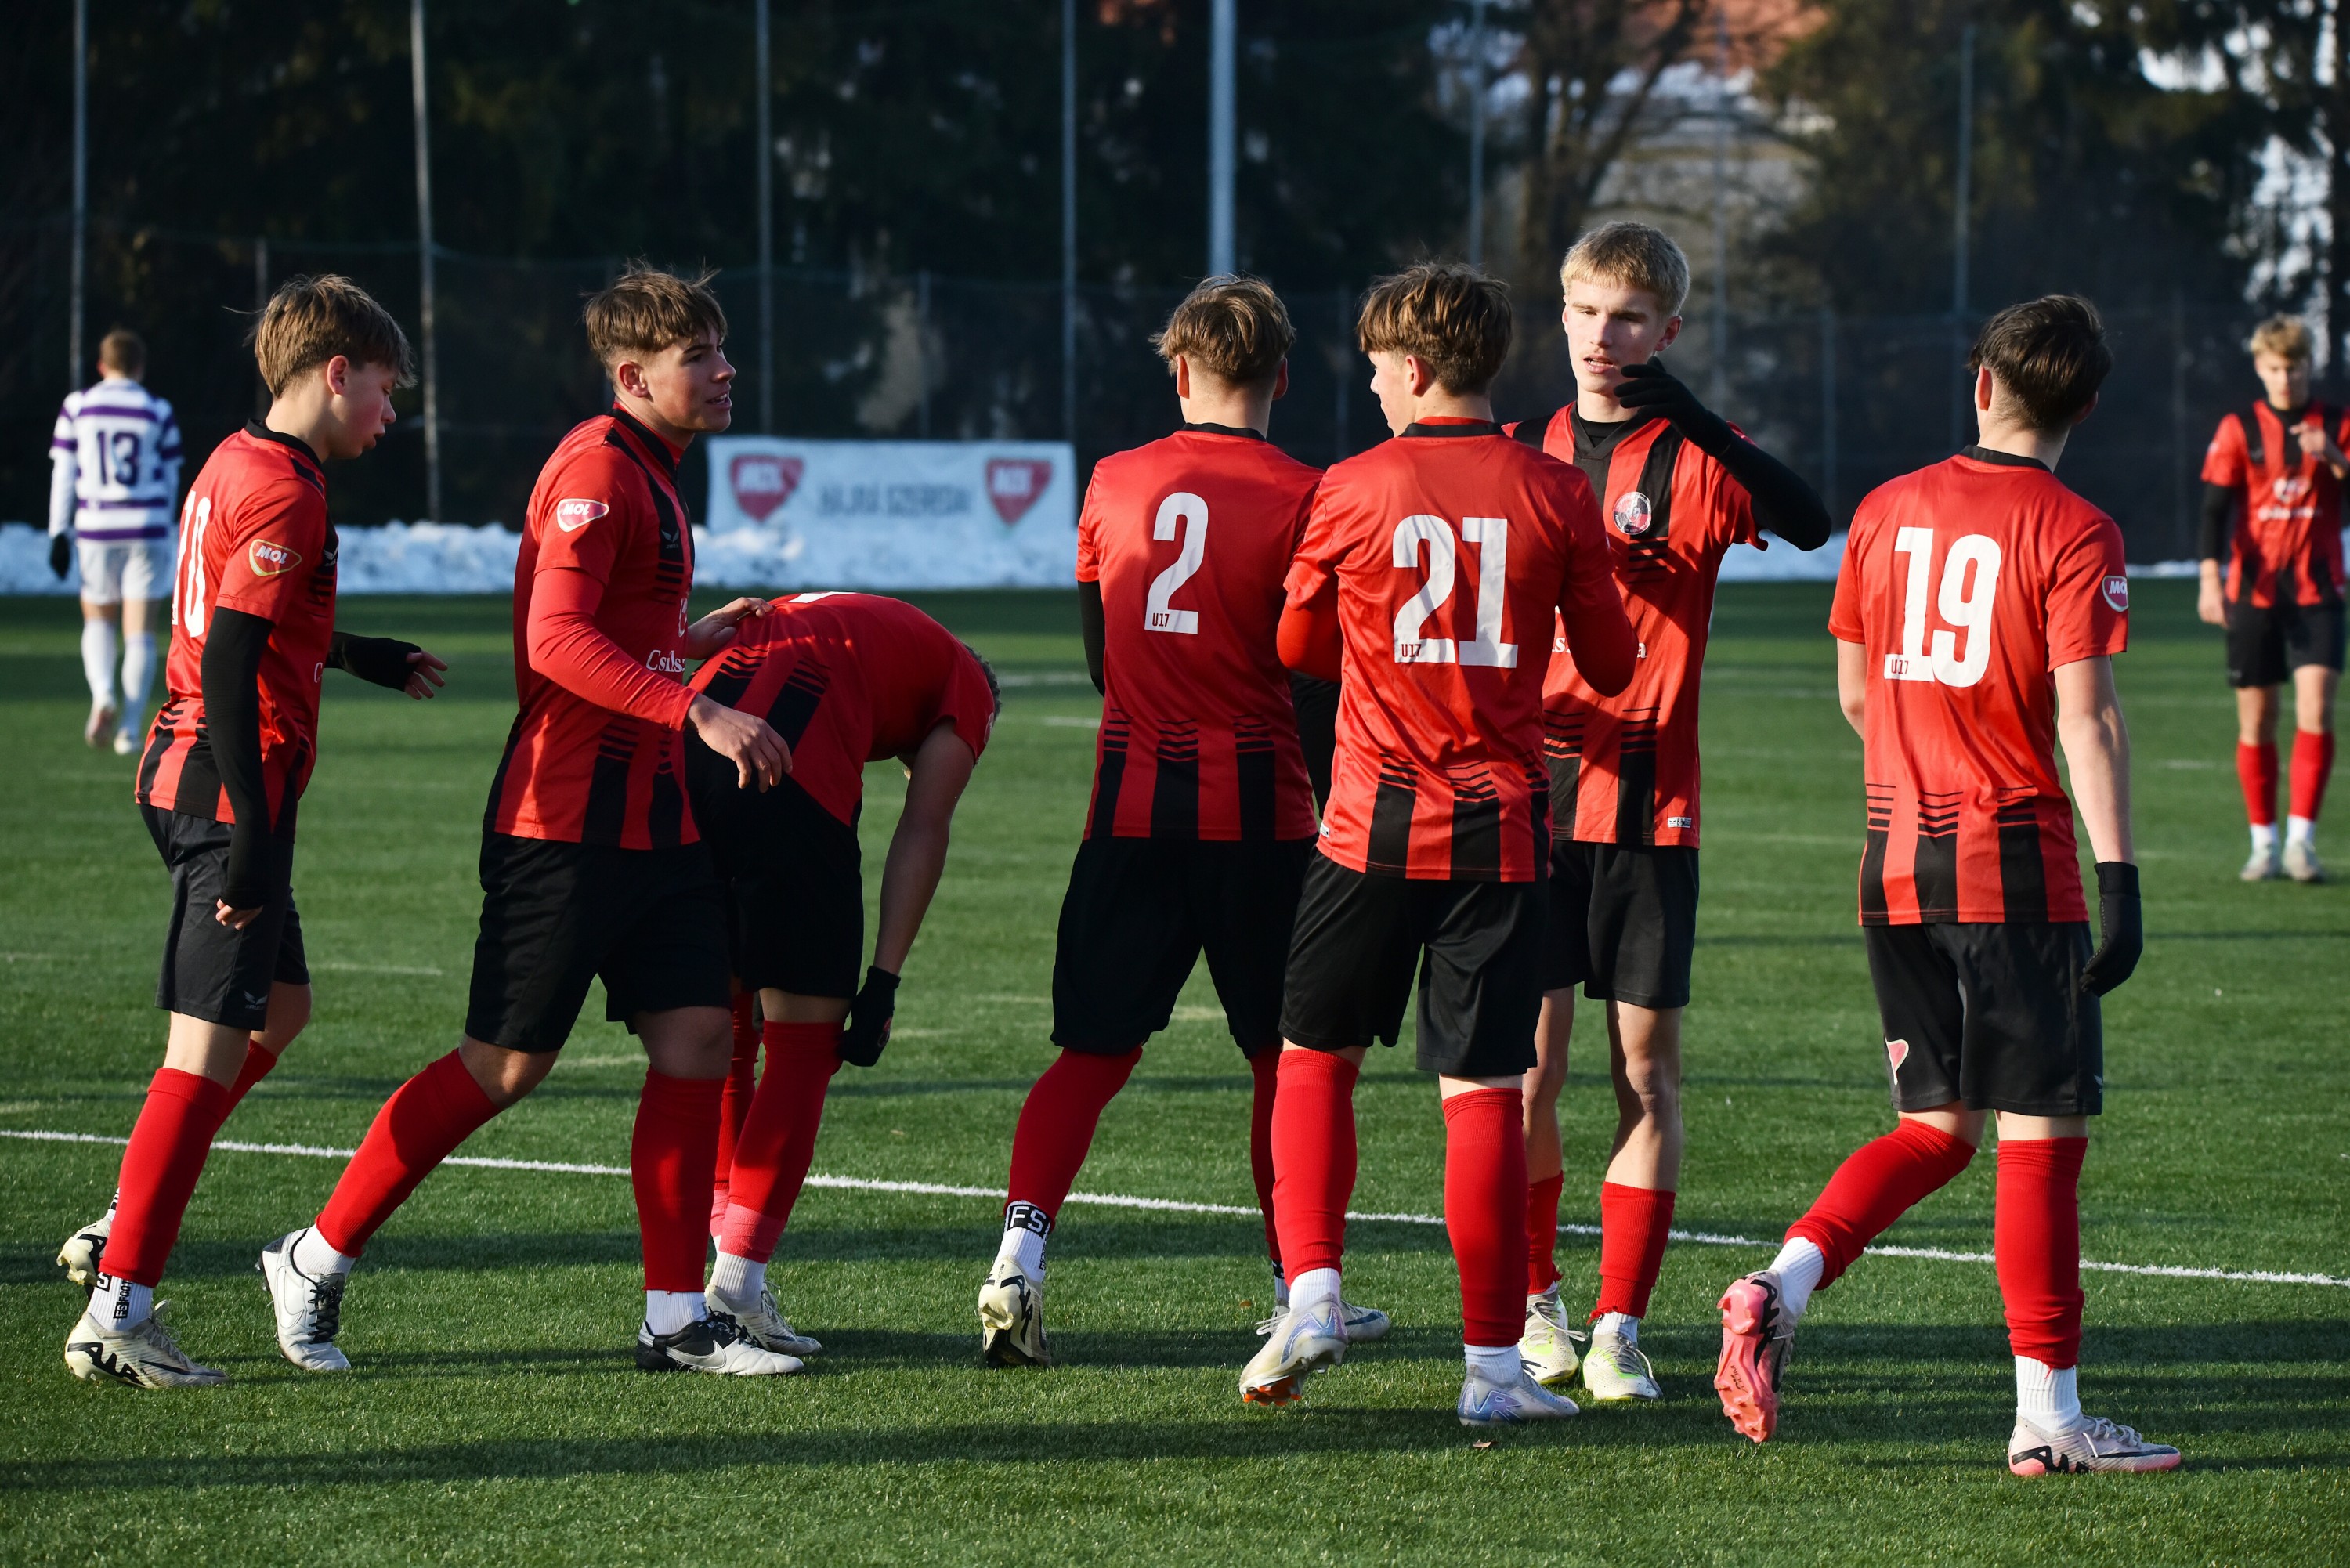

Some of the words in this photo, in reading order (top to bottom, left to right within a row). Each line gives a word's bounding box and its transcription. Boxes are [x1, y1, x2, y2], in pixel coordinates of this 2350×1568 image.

[97, 430, 139, 486] 13
[562, 503, 591, 516] MOL
[255, 544, 288, 564] MOL
[1144, 492, 1209, 635] 2
[1393, 514, 1518, 668] 21
[2109, 580, 2128, 594] MO
[1883, 526, 2002, 688] 19
[1152, 612, 1170, 627] U17
[1401, 644, 1422, 657] U17
[1891, 659, 1909, 674] U17
[1009, 1205, 1047, 1233] FS
[115, 1304, 128, 1317] FS
